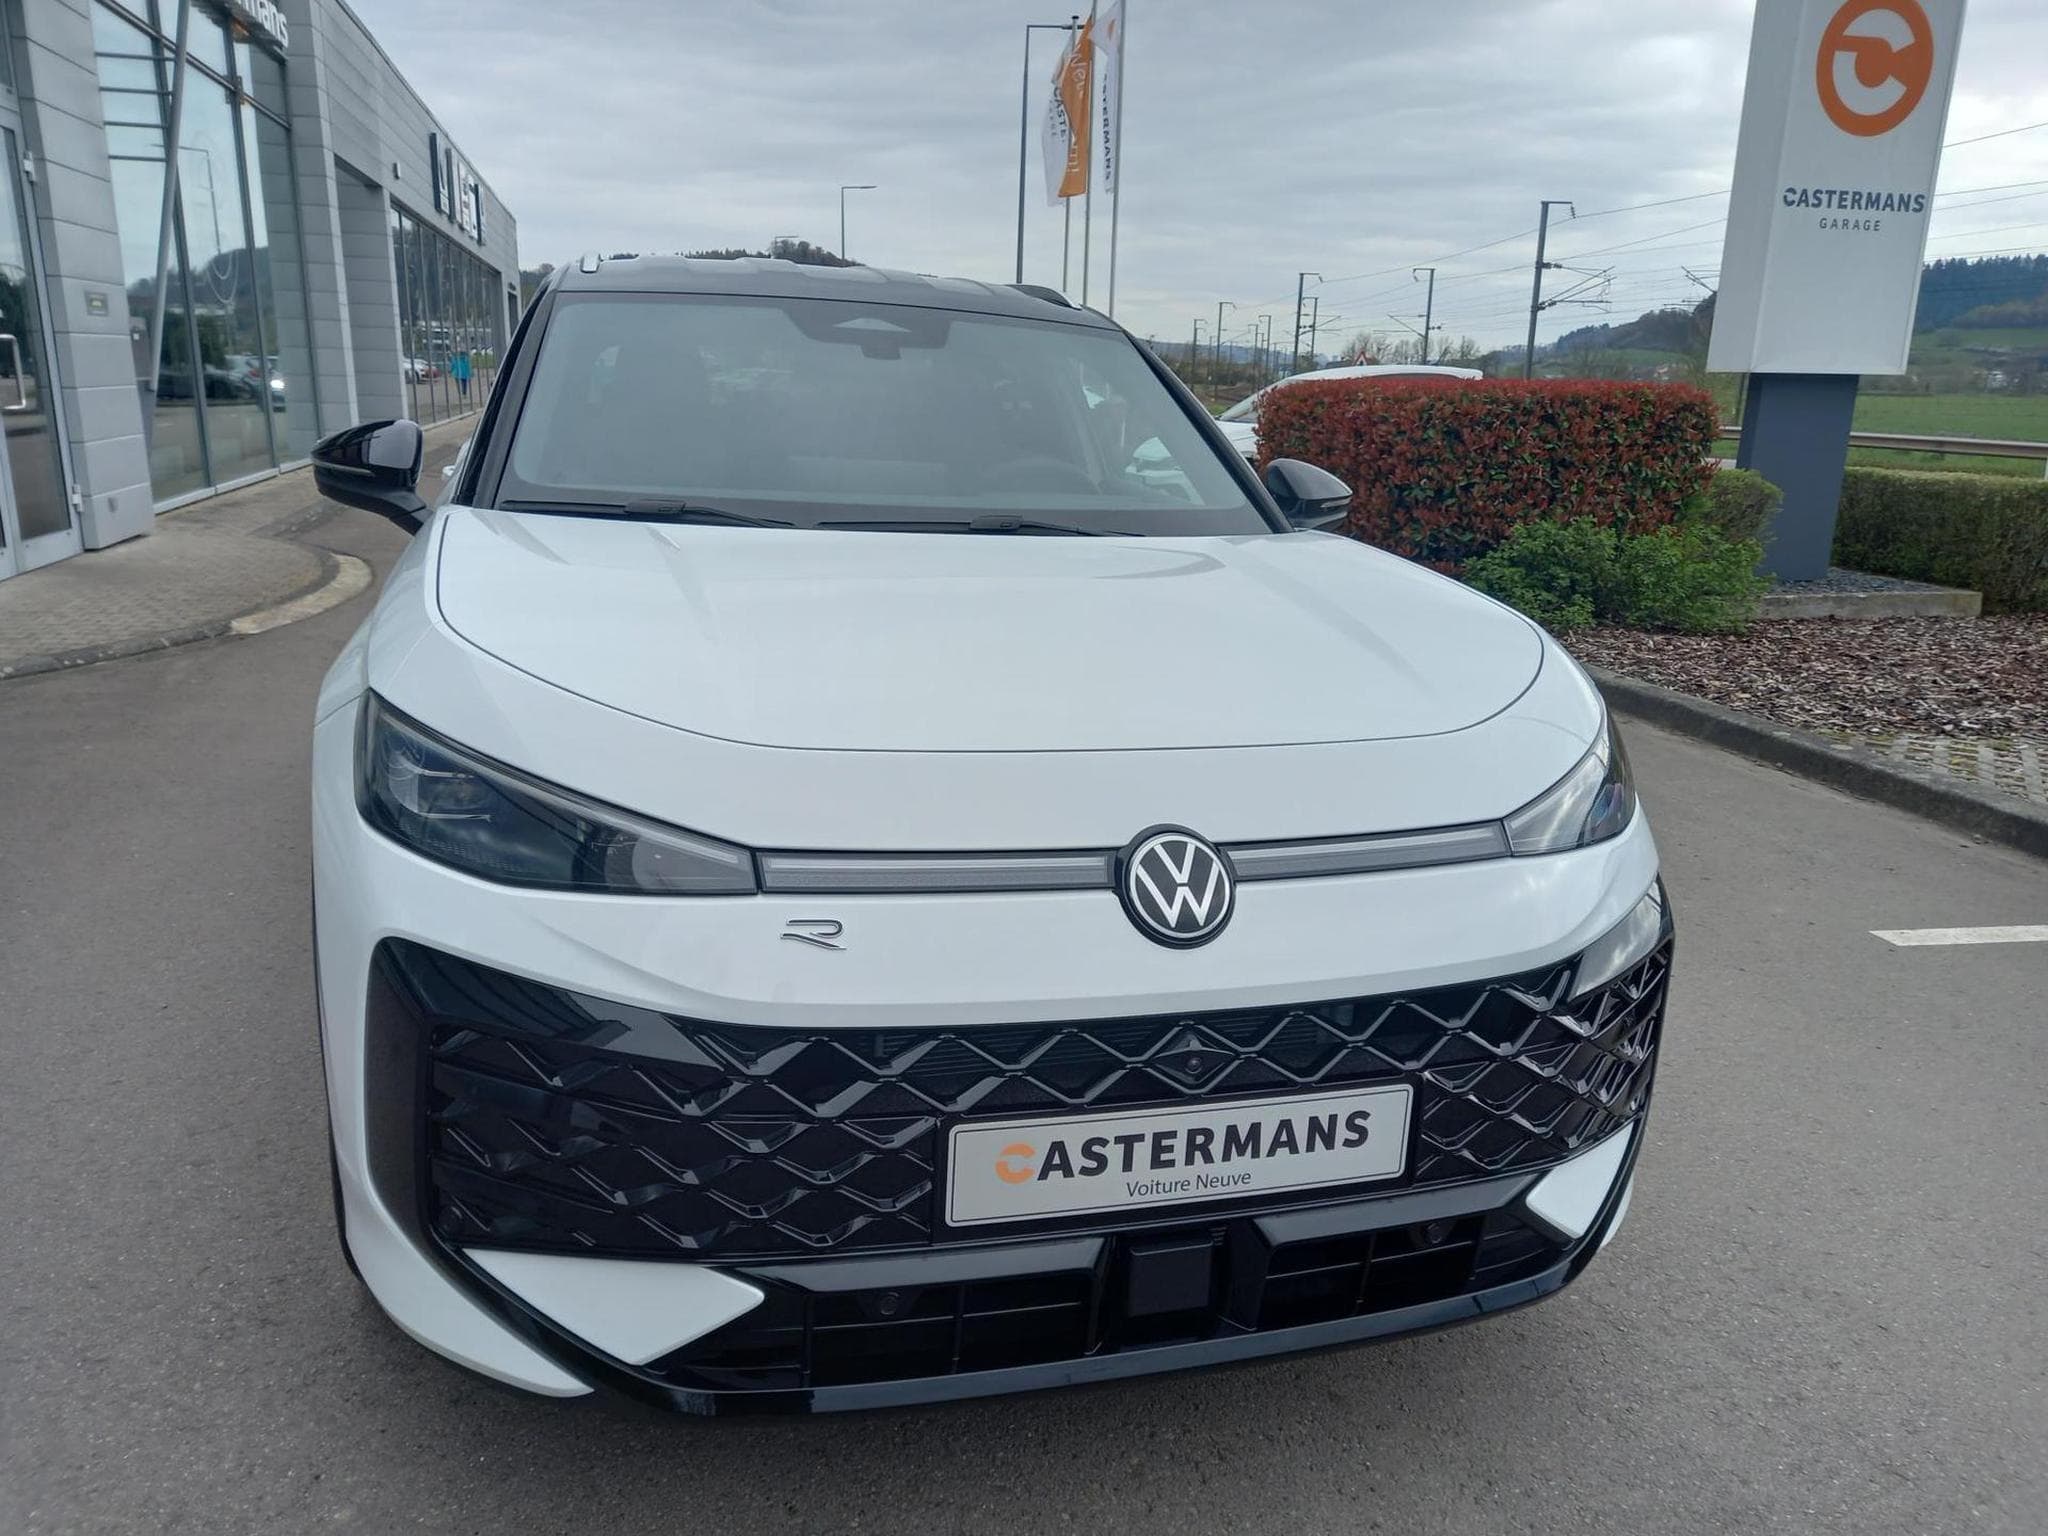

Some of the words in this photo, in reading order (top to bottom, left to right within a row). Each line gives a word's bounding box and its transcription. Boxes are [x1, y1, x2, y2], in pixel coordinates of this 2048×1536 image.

[1783, 187, 1925, 213] CASTERMANS
[1819, 217, 1881, 231] GARAGE
[995, 1110, 1372, 1184] CASTERMANS
[1126, 1179, 1191, 1198] Voiture
[1196, 1171, 1252, 1190] Neuve
